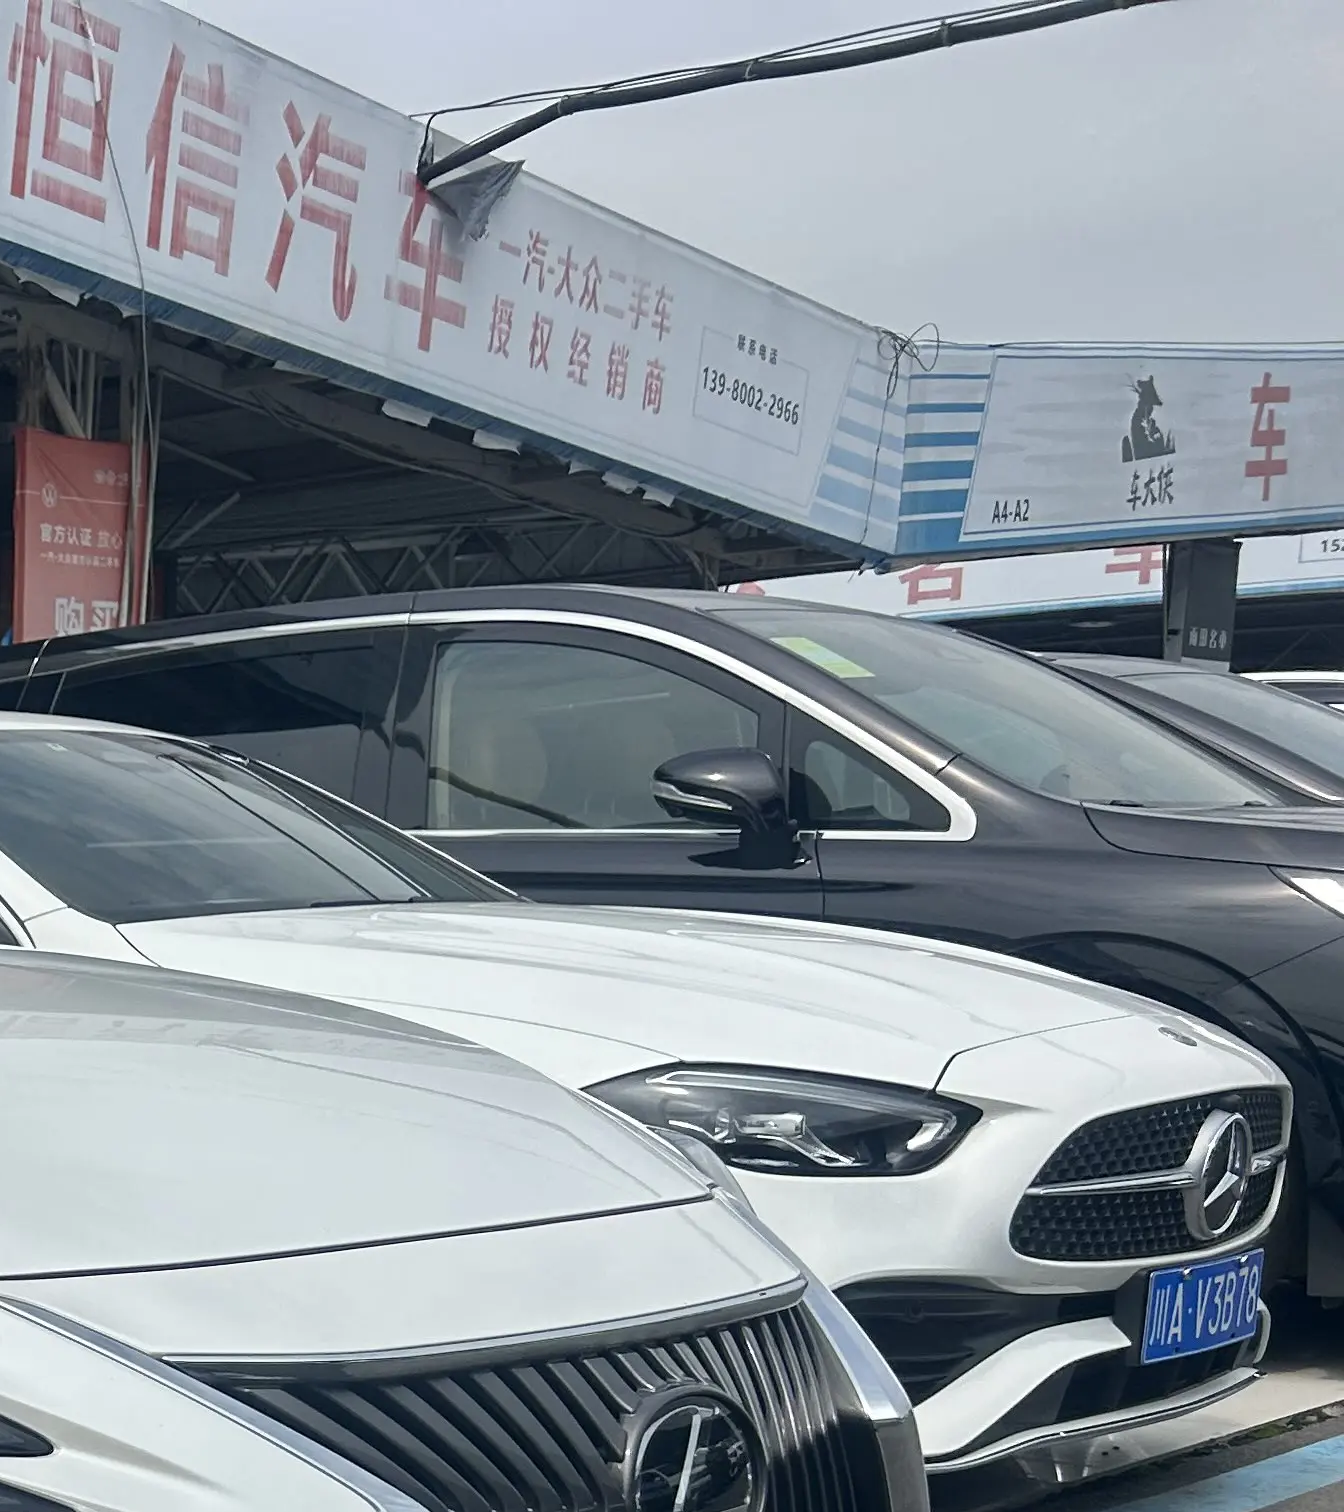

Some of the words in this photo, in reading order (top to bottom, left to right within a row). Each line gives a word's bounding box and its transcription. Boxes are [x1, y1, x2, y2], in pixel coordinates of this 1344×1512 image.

[486, 292, 667, 415] 授权经销商
[701, 366, 800, 426] 139-8002-2966
[1244, 371, 1291, 502] 车
